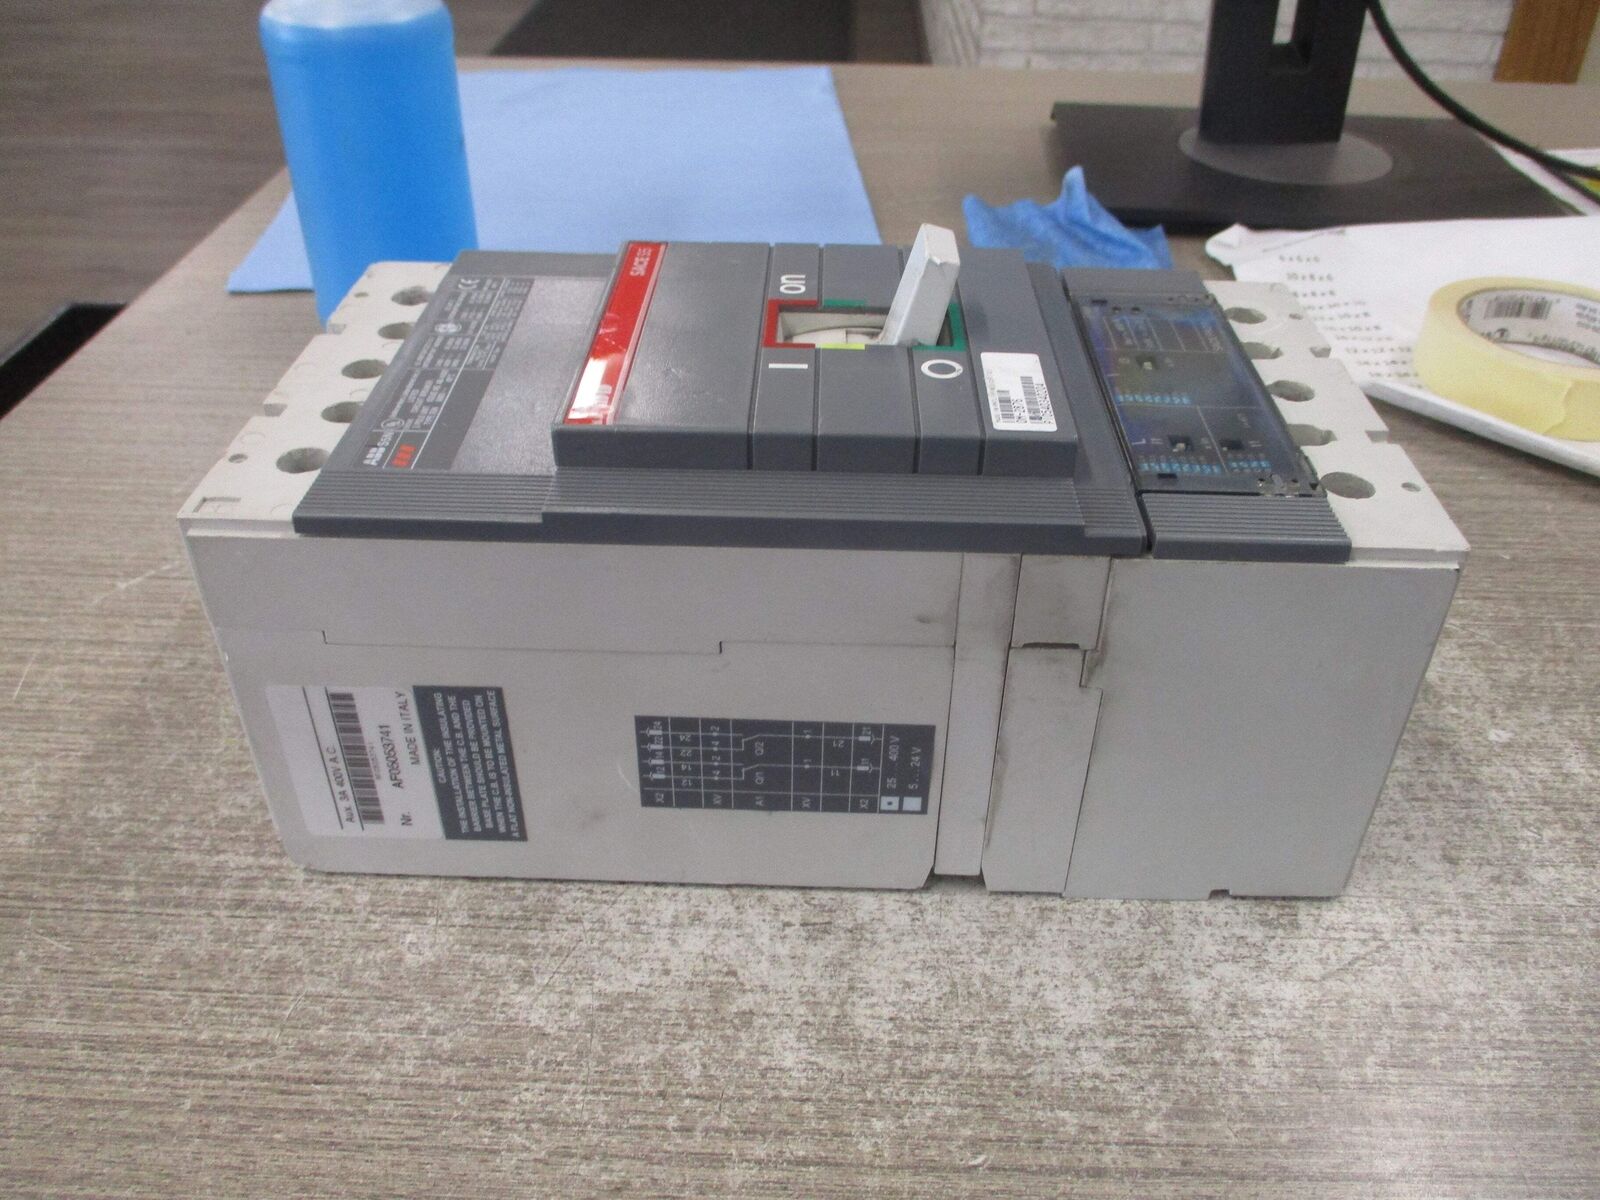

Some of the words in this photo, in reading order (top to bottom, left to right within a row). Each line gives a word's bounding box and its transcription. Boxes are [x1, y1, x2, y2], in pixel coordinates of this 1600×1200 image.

[779, 274, 806, 294] on
[363, 447, 386, 466] ABB
[395, 691, 411, 719] ITALY
[447, 695, 458, 710] THE
[474, 695, 484, 707] ON
[486, 690, 501, 726] SURFACE
[433, 692, 451, 738] INSULATING
[450, 712, 462, 729] AND
[461, 699, 477, 739] PROVIDED
[401, 724, 414, 733] IN
[476, 708, 491, 746] MOUNTED
[443, 740, 454, 754] THE
[469, 741, 479, 751] BE
[493, 727, 506, 753] METAL
[405, 737, 421, 764] MADE
[457, 747, 468, 761] THE
[483, 748, 493, 758] BE
[446, 757, 456, 766] OF
[472, 753, 485, 783] SHOULD
[486, 760, 495, 770] TO
[332, 766, 345, 786] 400V
[460, 763, 475, 799] BETWEEN
[497, 755, 516, 812] NON-INSULATED
[448, 768, 466, 818] INSTALLATION
[477, 785, 489, 807] PLATE
[492, 796, 502, 809] THE
[399, 811, 413, 825] Nr.
[467, 800, 481, 831] BARRIER
[482, 808, 493, 827] BASE
[495, 812, 506, 832] WHEN
[508, 813, 519, 831] FLAT
[459, 819, 469, 832] THE
